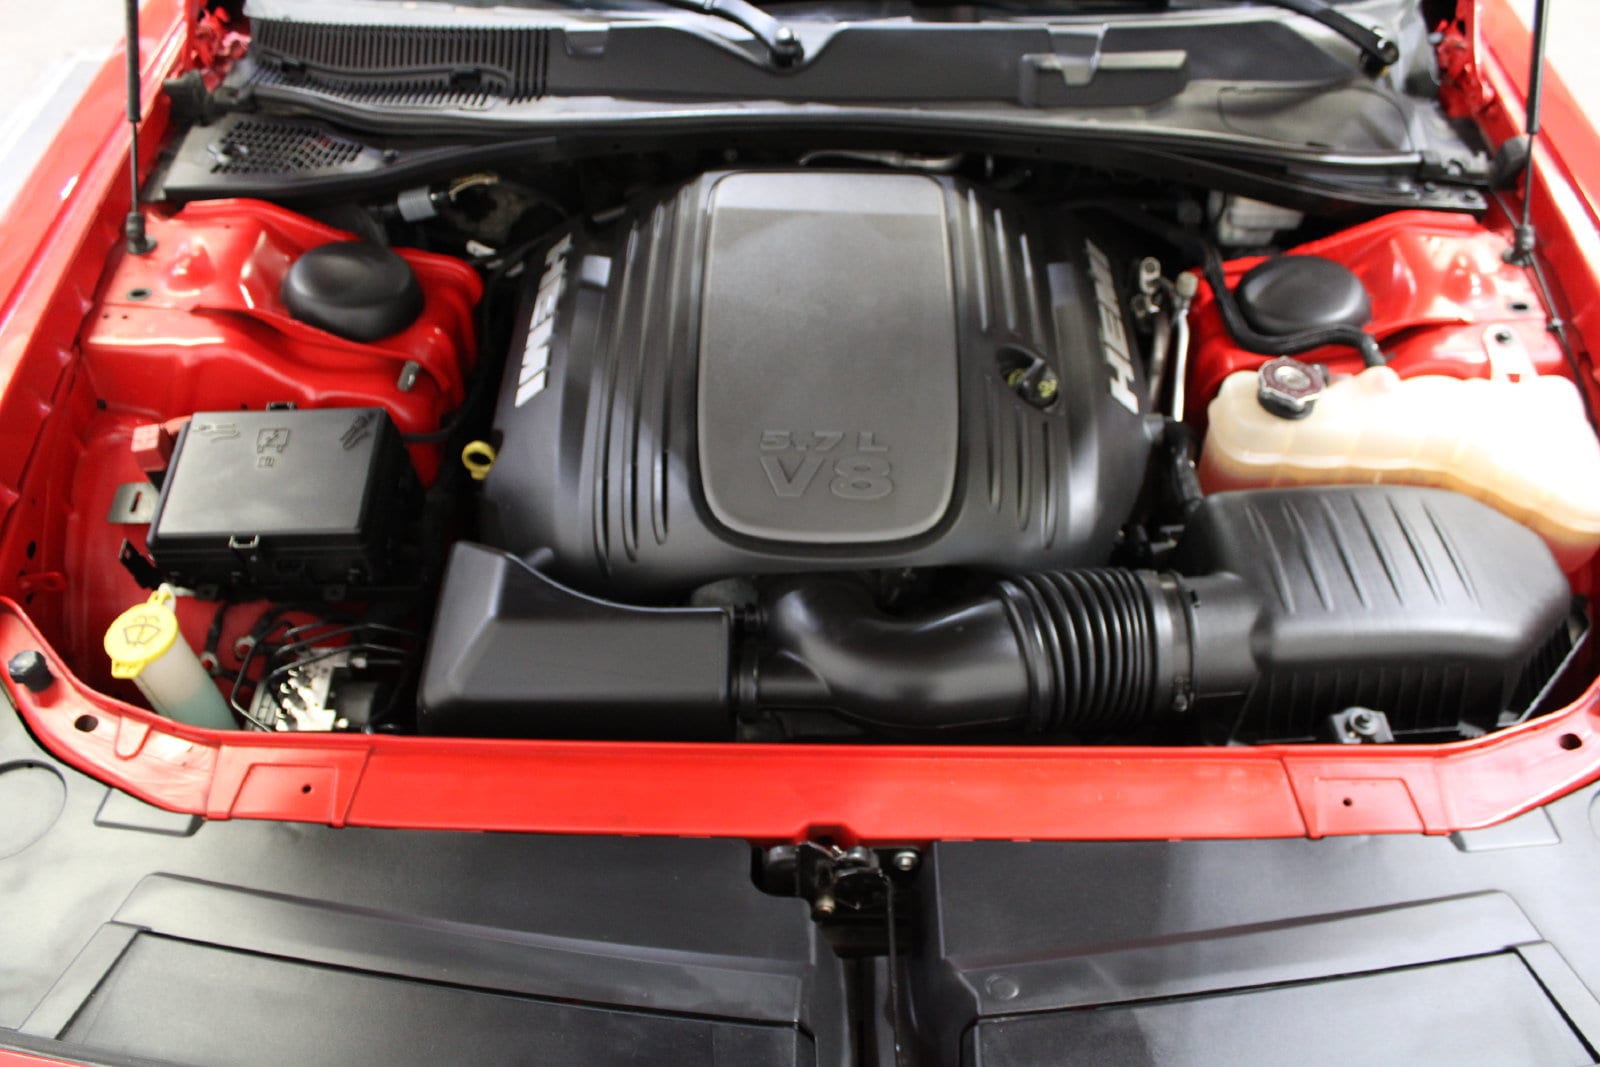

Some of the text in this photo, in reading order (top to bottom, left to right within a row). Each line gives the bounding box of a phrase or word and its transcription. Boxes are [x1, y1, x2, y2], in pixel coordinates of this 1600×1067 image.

[514, 232, 572, 408] HEMI
[1085, 237, 1139, 415] HEMI
[759, 455, 895, 500] V8
